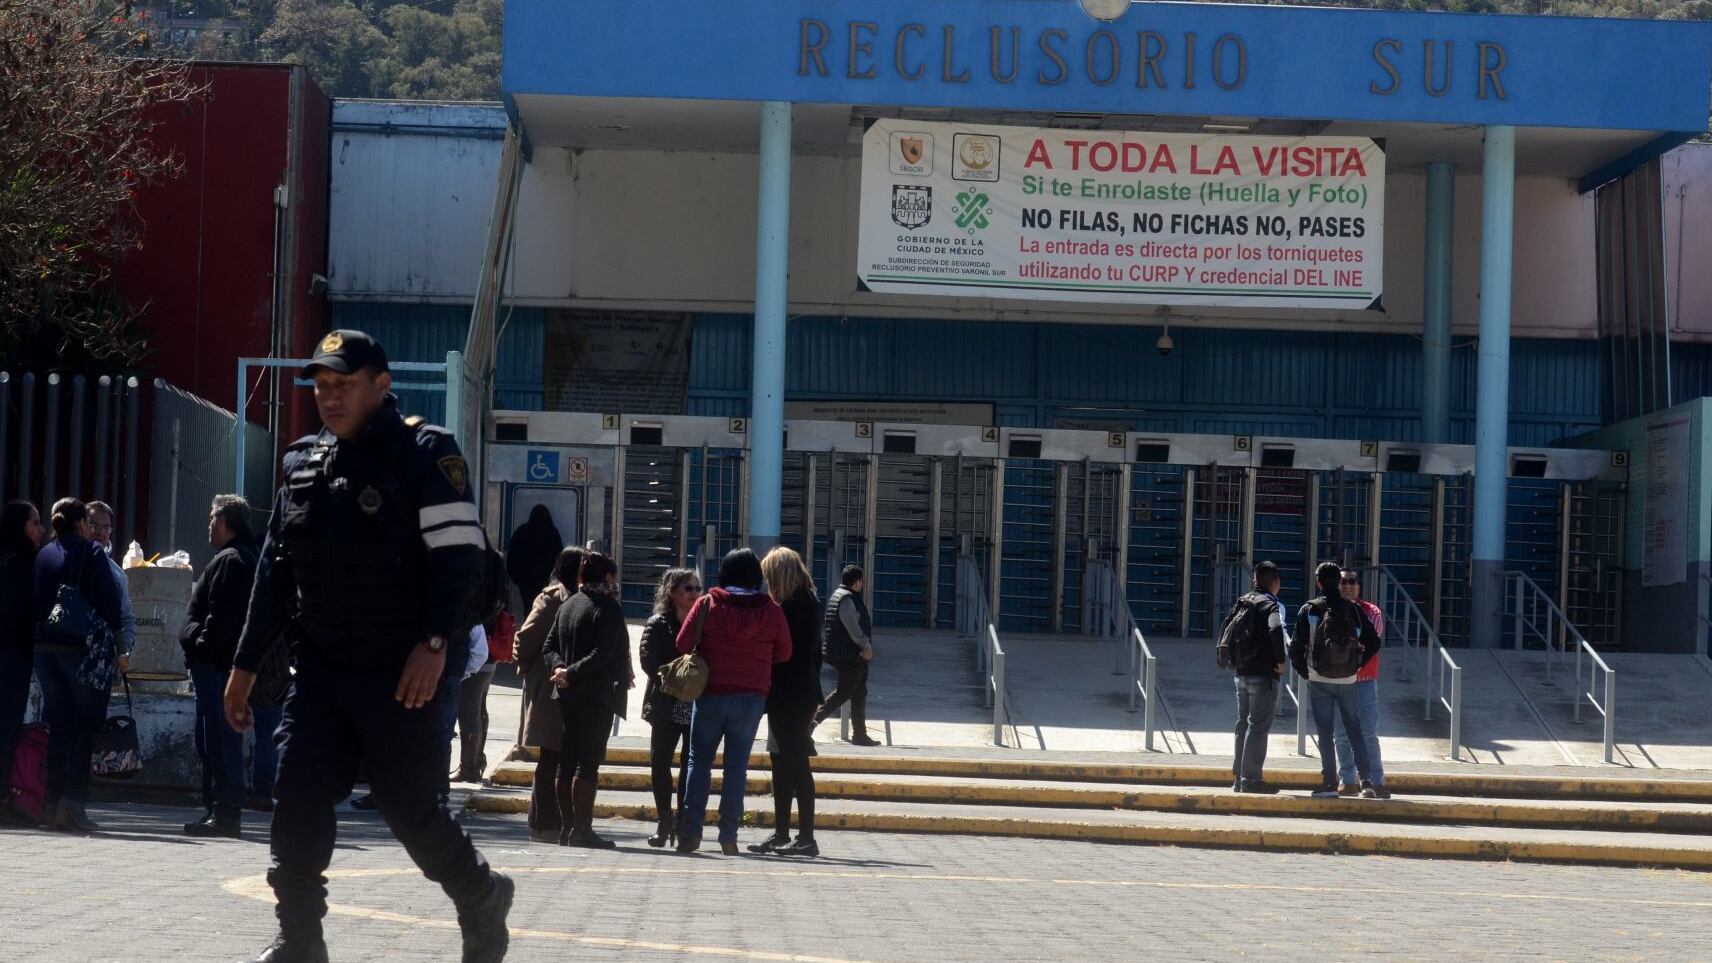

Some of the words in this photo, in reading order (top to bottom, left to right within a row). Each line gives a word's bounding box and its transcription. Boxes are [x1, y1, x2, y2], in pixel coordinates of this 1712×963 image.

[798, 18, 1249, 91] RECLUSORIO
[1371, 38, 1508, 100] SUR
[1024, 139, 1053, 170] A
[1064, 141, 1177, 174] TODA
[1190, 144, 1242, 176] LA
[1252, 146, 1367, 178] VISITA
[1022, 175, 1044, 196] Si
[1051, 178, 1073, 197] te
[1081, 178, 1192, 201] Enrolaste
[1200, 182, 1280, 206] (Huella
[1288, 188, 1302, 208] y
[1308, 183, 1368, 209] Foto)
[1022, 208, 1052, 229] NO
[1059, 210, 1125, 237] FILAS,
[1133, 212, 1164, 234] NO
[1171, 214, 1249, 236] FICHAS
[1255, 215, 1291, 241] NO,
[1299, 216, 1365, 238] PASES
[897, 235, 950, 245] GOBIERNO
[954, 238, 967, 246] DE
[971, 239, 984, 247] LA
[896, 245, 932, 254] CIUDAD
[949, 247, 984, 256] MÉXICO
[1020, 236, 1040, 253] La
[1045, 239, 1109, 256] entrada
[1115, 244, 1134, 257] es
[1140, 241, 1197, 259] directa
[1203, 246, 1231, 262] por
[1237, 244, 1262, 261] los
[1267, 245, 1364, 265] torniquetes
[872, 263, 916, 272] RECLUSORIO
[917, 266, 960, 274] PREVENTIVO
[951, 260, 991, 268] SEGURIDAD
[1019, 262, 1101, 278] utilizando
[1107, 265, 1123, 281] tu
[1129, 264, 1179, 282] CURP
[1184, 266, 1196, 283] Y
[1200, 268, 1288, 286] credencial
[1294, 269, 1328, 286] DEL
[1334, 270, 1363, 287] INE
[607, 416, 614, 427] 1
[734, 420, 743, 431] 2
[860, 424, 869, 435] 3
[985, 429, 995, 440] 4
[1112, 434, 1121, 446] 5
[1237, 438, 1247, 448] 6
[1364, 443, 1375, 454] 7
[1615, 453, 1624, 464] 9
